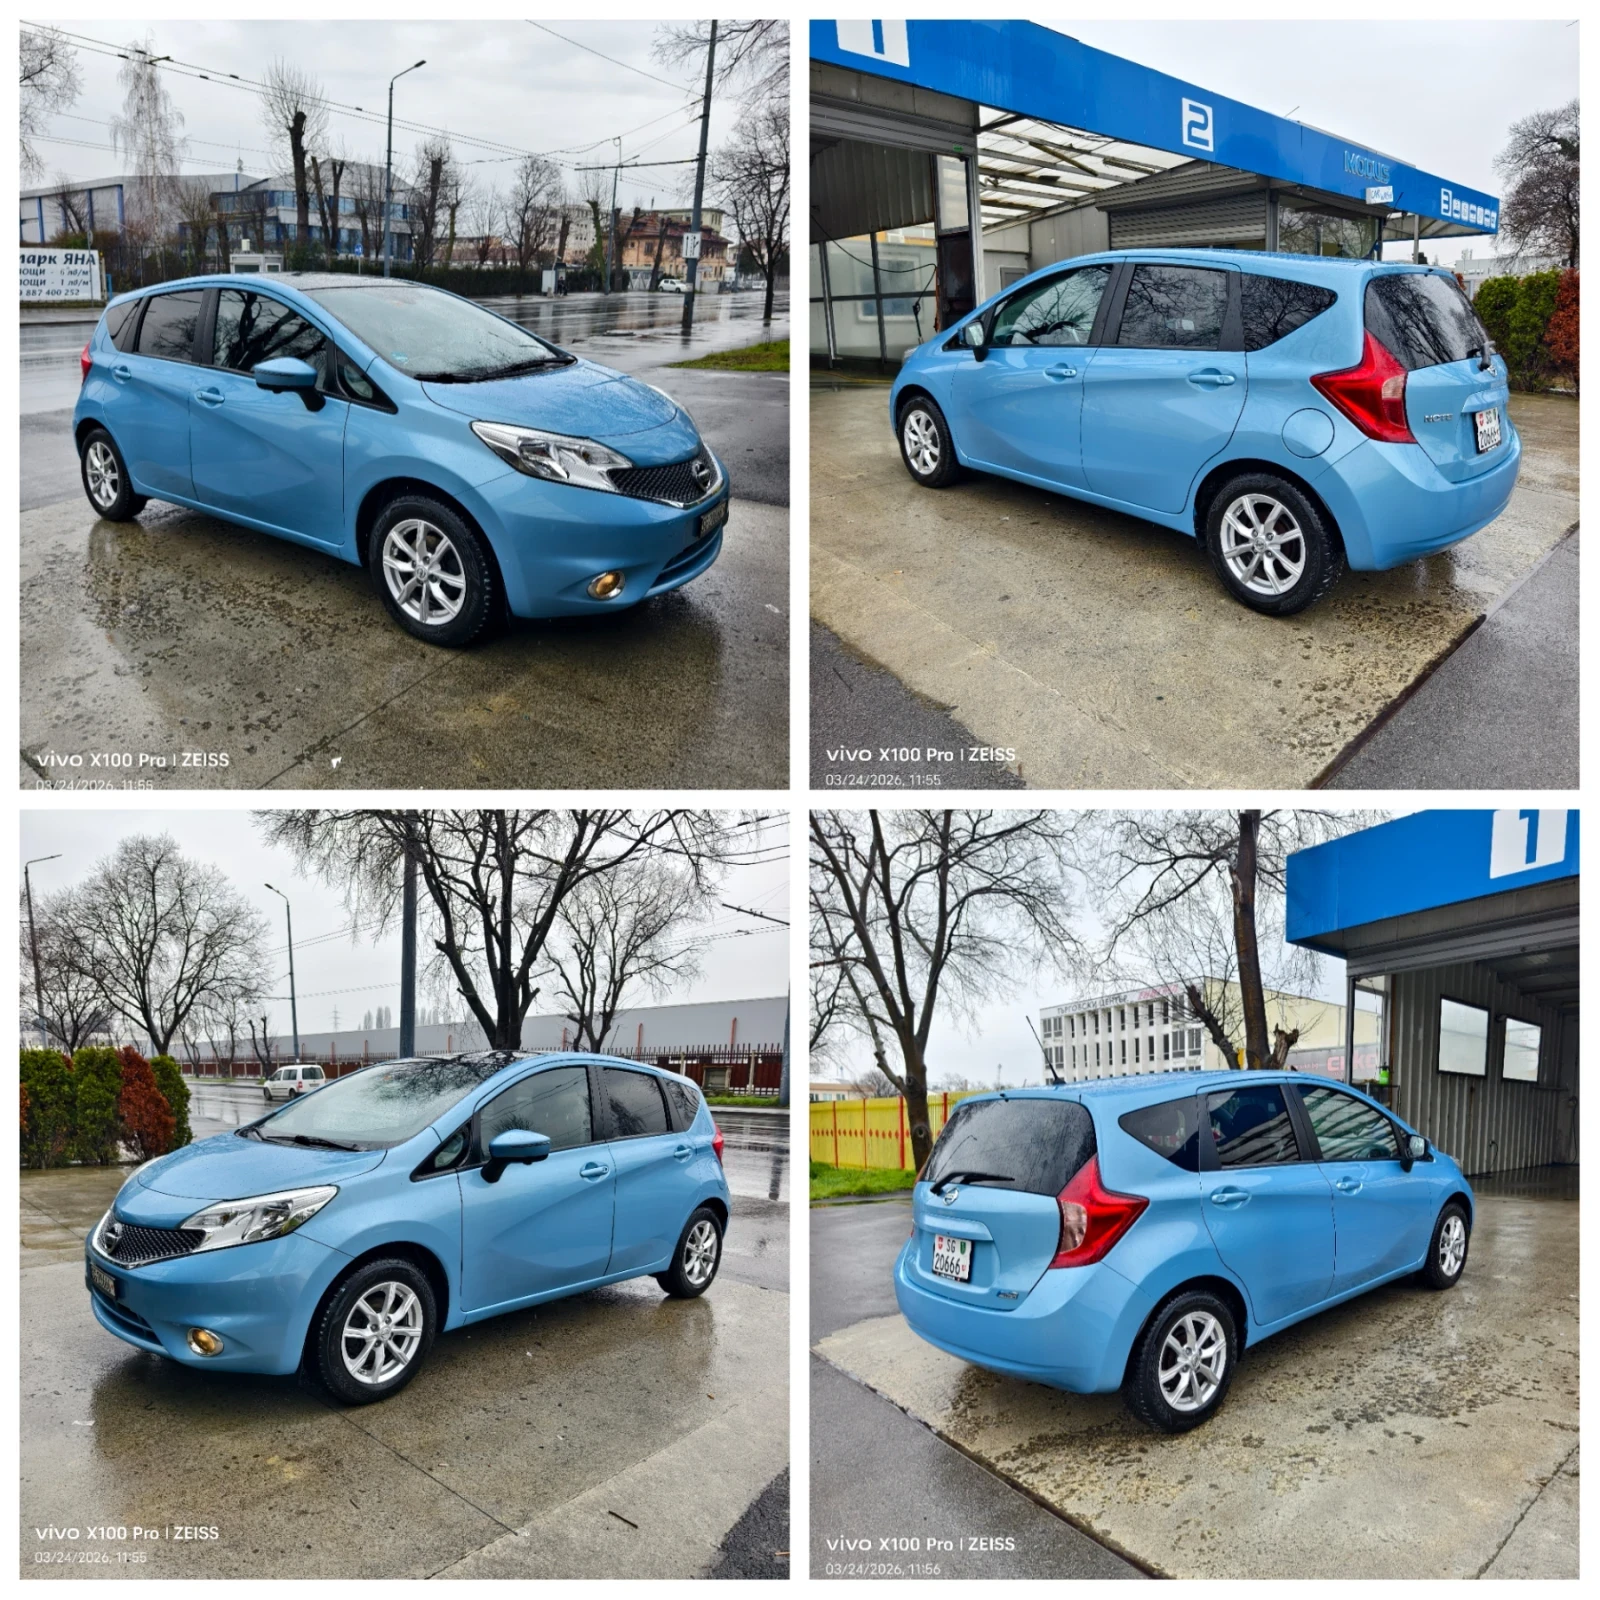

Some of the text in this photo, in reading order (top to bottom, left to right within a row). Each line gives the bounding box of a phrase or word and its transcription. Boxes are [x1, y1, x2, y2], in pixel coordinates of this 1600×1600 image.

[1187, 103, 1210, 148] 2
[1344, 150, 1390, 185] MODUS
[1442, 190, 1451, 214] 3
[63, 252, 96, 266] ЯНА
[25, 288, 43, 297] 887
[64, 288, 80, 296] 252
[1423, 413, 1453, 423] NOTE
[1519, 809, 1539, 865] 1
[1057, 1000, 1097, 1014] ТЪРГОВСКИ
[946, 1238, 956, 1253] SG
[934, 1252, 961, 1275] 20666
